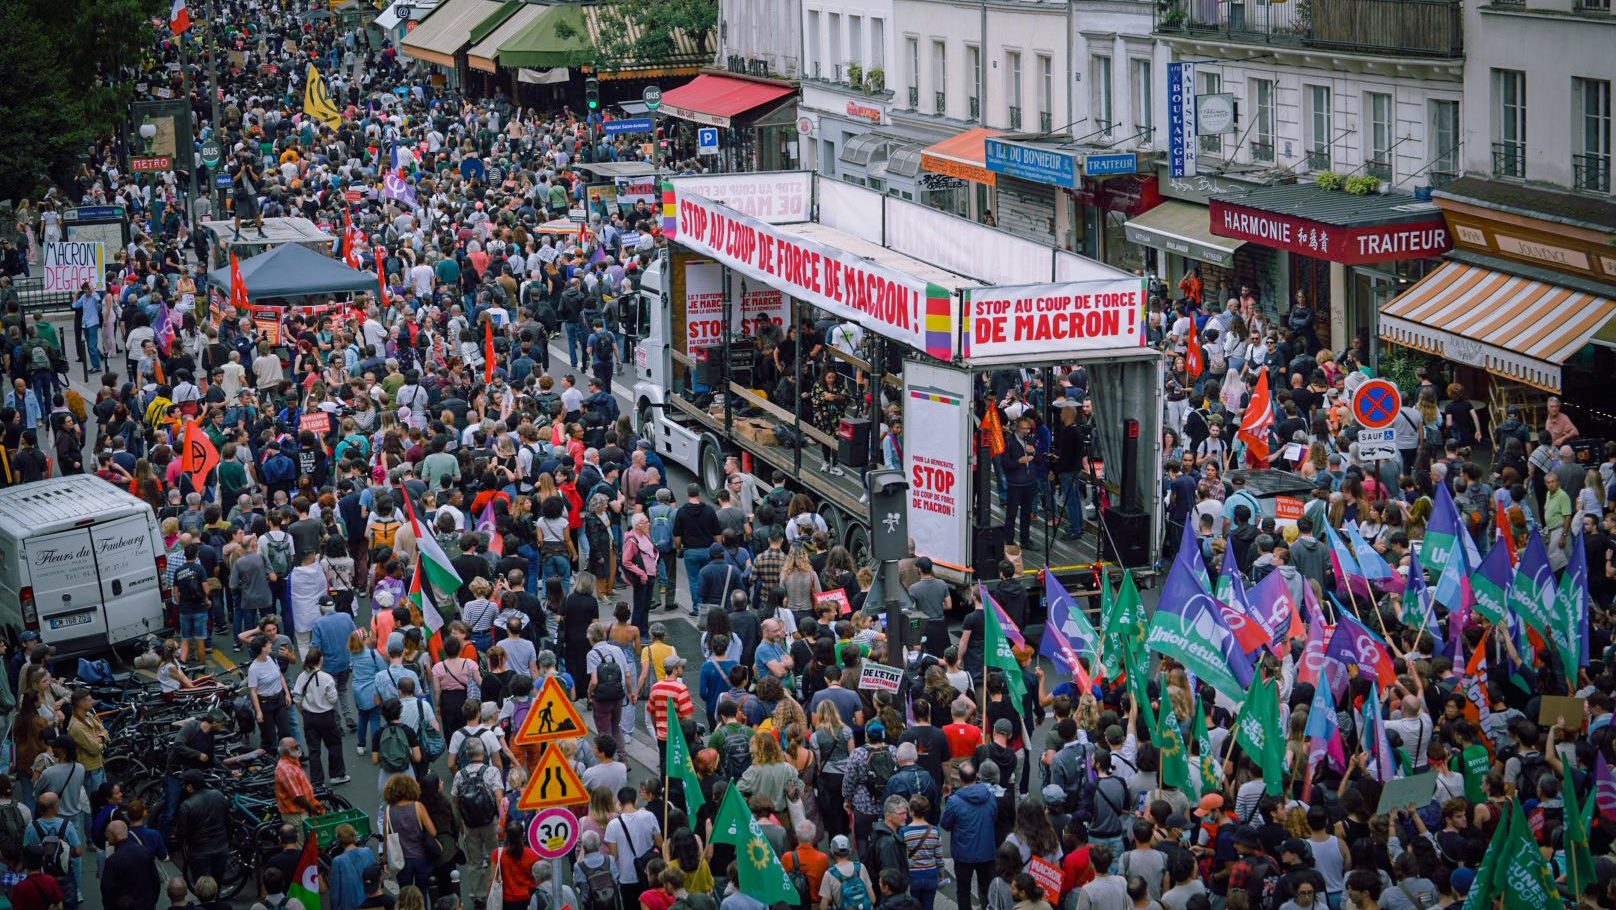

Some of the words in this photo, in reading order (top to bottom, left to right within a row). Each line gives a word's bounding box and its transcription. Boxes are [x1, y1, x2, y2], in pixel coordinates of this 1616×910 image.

[646, 91, 659, 100] BUS
[1184, 64, 1194, 160] PATISSIER
[704, 132, 712, 144] P
[1172, 84, 1183, 176] BOULANGER
[203, 147, 218, 156] BUS
[1010, 147, 1021, 162] DU
[1024, 150, 1061, 170] BONHEUR
[1088, 159, 1132, 170] TRAITEUR
[1224, 210, 1291, 243] HARMONIE
[1166, 241, 1189, 253] BOULANGER
[1357, 229, 1446, 255] TRAITEUR
[1518, 241, 1568, 264] JOUVENCE
[45, 243, 96, 266] MACRON
[681, 199, 707, 242] STOP
[708, 212, 724, 251] AU
[726, 218, 756, 264] COUP
[758, 232, 774, 274] DE
[777, 239, 820, 293] FORCE
[824, 256, 842, 302] DE
[844, 265, 909, 330] MACRON
[914, 291, 919, 334] !
[688, 301, 698, 309] JE
[752, 297, 782, 306] MARCHE
[976, 300, 1010, 316] STOP
[1014, 298, 1032, 313] AU
[1037, 296, 1071, 311] COUP
[1075, 295, 1091, 309] DE
[1095, 292, 1136, 308] FORCE
[976, 317, 1007, 344] DE
[1014, 310, 1119, 341] MACRON
[1128, 309, 1135, 334] !
[1362, 432, 1383, 440] SAUF
[913, 464, 955, 494] STOP
[913, 498, 922, 509] DE
[924, 500, 951, 516] MACRON
[921, 491, 933, 499] COUP
[941, 495, 954, 505] FORCE
[35, 549, 74, 565] Fleurs
[77, 546, 90, 558] du
[95, 535, 144, 554] Faubourg
[1150, 625, 1189, 650] Union
[862, 678, 898, 688] PALESTINIEN
[540, 822, 568, 844] 30
